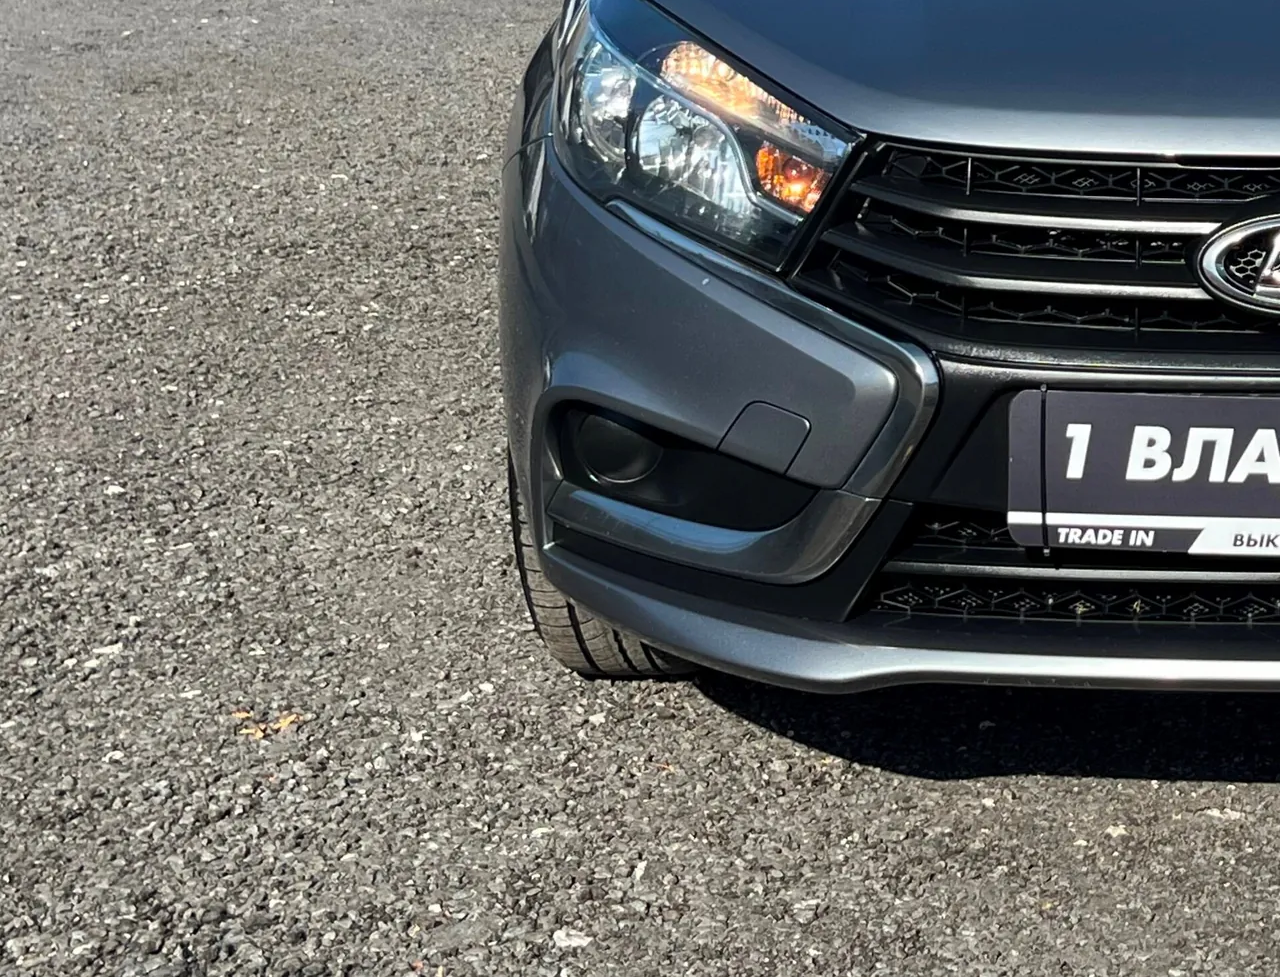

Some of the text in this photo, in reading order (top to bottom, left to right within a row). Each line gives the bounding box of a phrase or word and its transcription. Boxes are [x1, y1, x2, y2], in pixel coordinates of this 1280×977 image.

[1065, 423, 1092, 479] 1
[1057, 527, 1155, 547] TRADE IN
